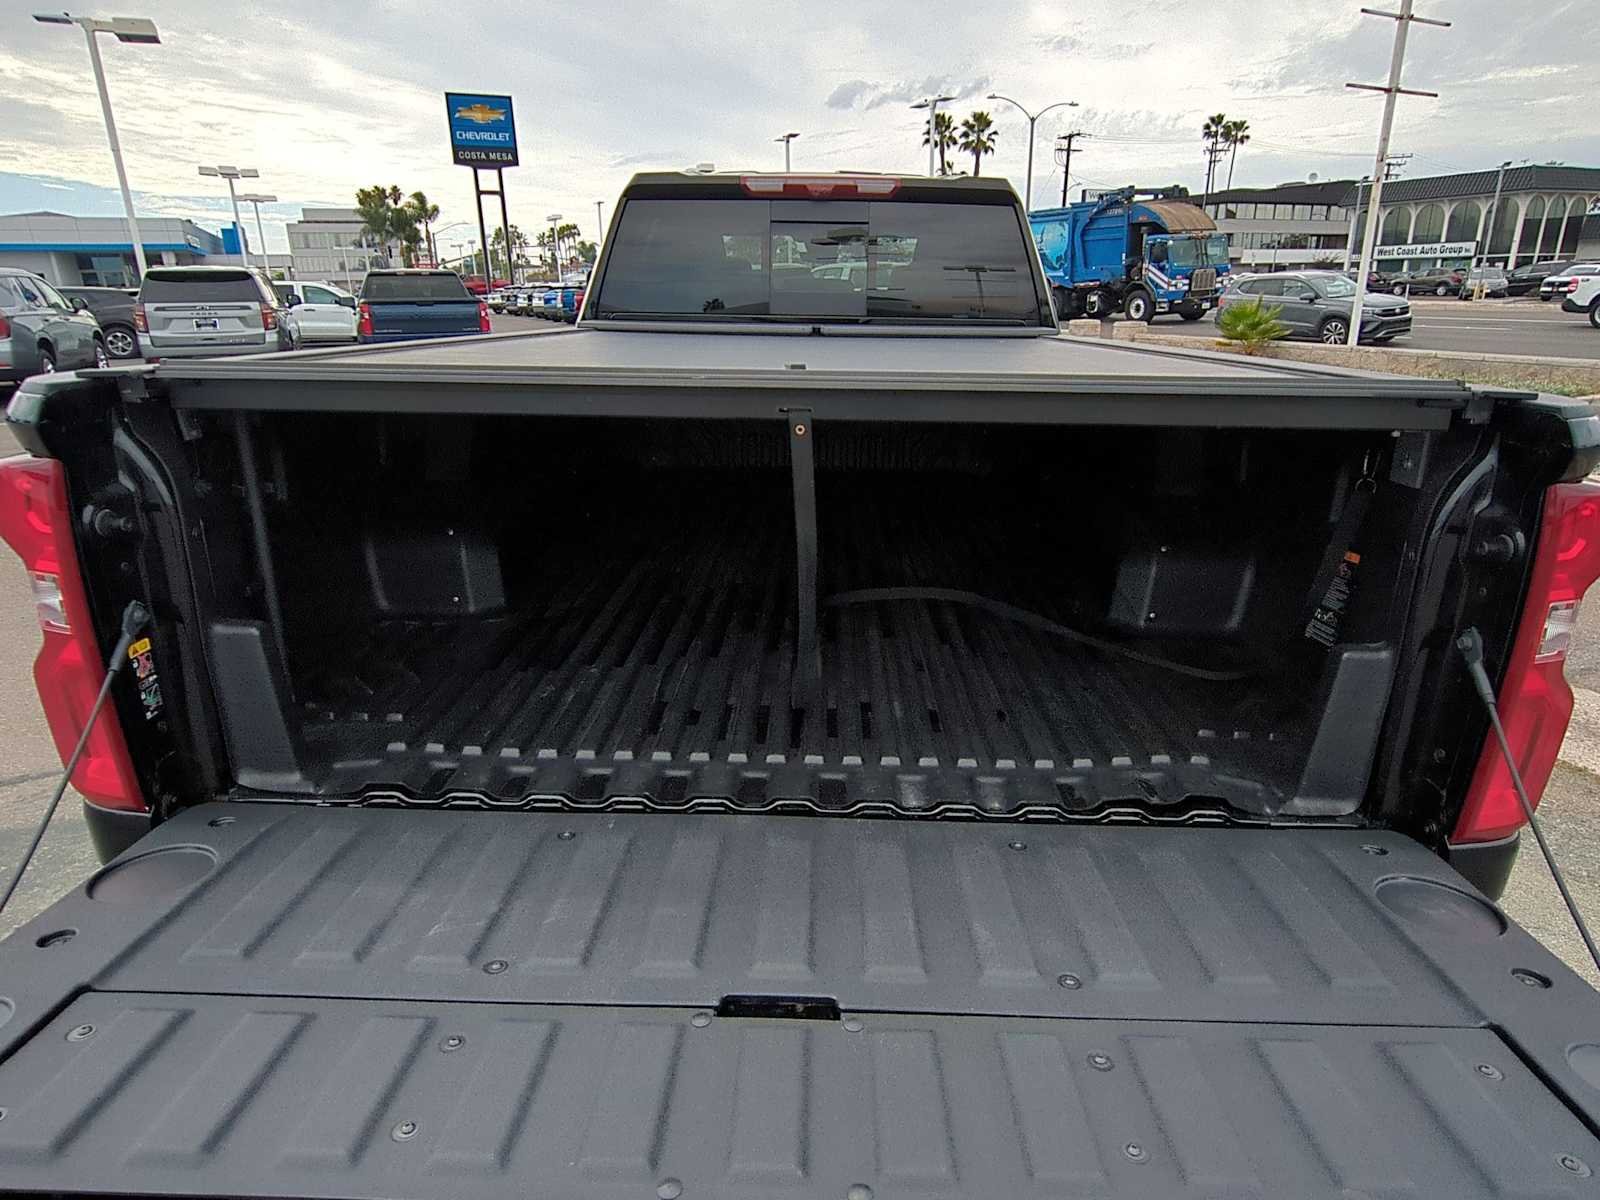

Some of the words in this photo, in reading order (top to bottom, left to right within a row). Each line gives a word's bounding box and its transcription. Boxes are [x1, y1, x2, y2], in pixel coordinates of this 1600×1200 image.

[456, 131, 510, 141] CHEVROLET
[458, 151, 487, 160] COSTA
[489, 152, 513, 161] MESA
[1377, 247, 1395, 256] West
[1396, 246, 1418, 256] Coast
[1420, 246, 1437, 255] Auto
[1439, 245, 1464, 255] Group
